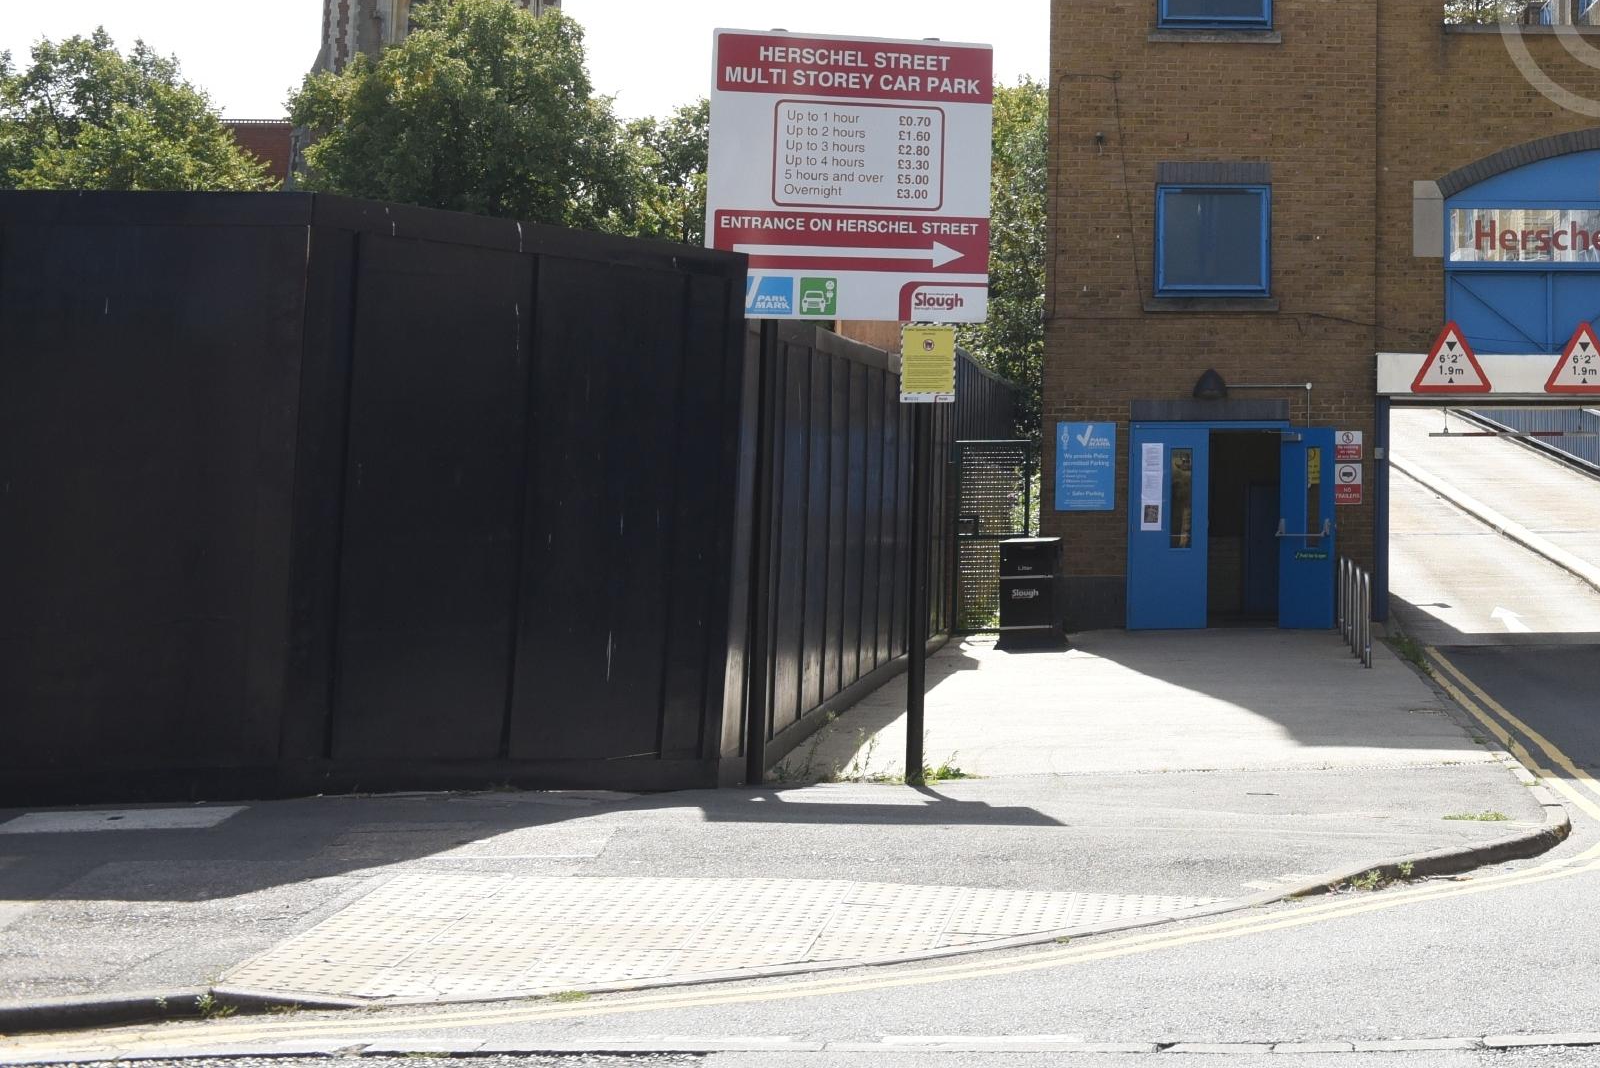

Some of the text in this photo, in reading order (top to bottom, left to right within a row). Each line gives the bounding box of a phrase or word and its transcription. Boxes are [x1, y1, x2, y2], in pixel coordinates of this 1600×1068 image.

[760, 46, 951, 72] HERSCHEL STREET
[725, 66, 981, 95] MULTI STOREY CAR PARK
[787, 110, 931, 127] Up to 1 hour £0.70
[786, 125, 930, 142] Up to 2 hours £1.60
[786, 140, 930, 156] Up to 3 hours £2.80
[785, 154, 930, 171] Up to 4 hours £3.30
[784, 169, 929, 185] 5 hours and over £5.00
[784, 184, 928, 199] Overnight £3.00
[720, 216, 979, 236] ENTRANCE ON HERSCHEL STREET
[755, 301, 790, 309] MARK
[914, 292, 964, 310] Slough
[1439, 366, 1464, 376] 1.9m
[1572, 366, 1597, 376] 1.9m
[1012, 588, 1039, 599] Slough
